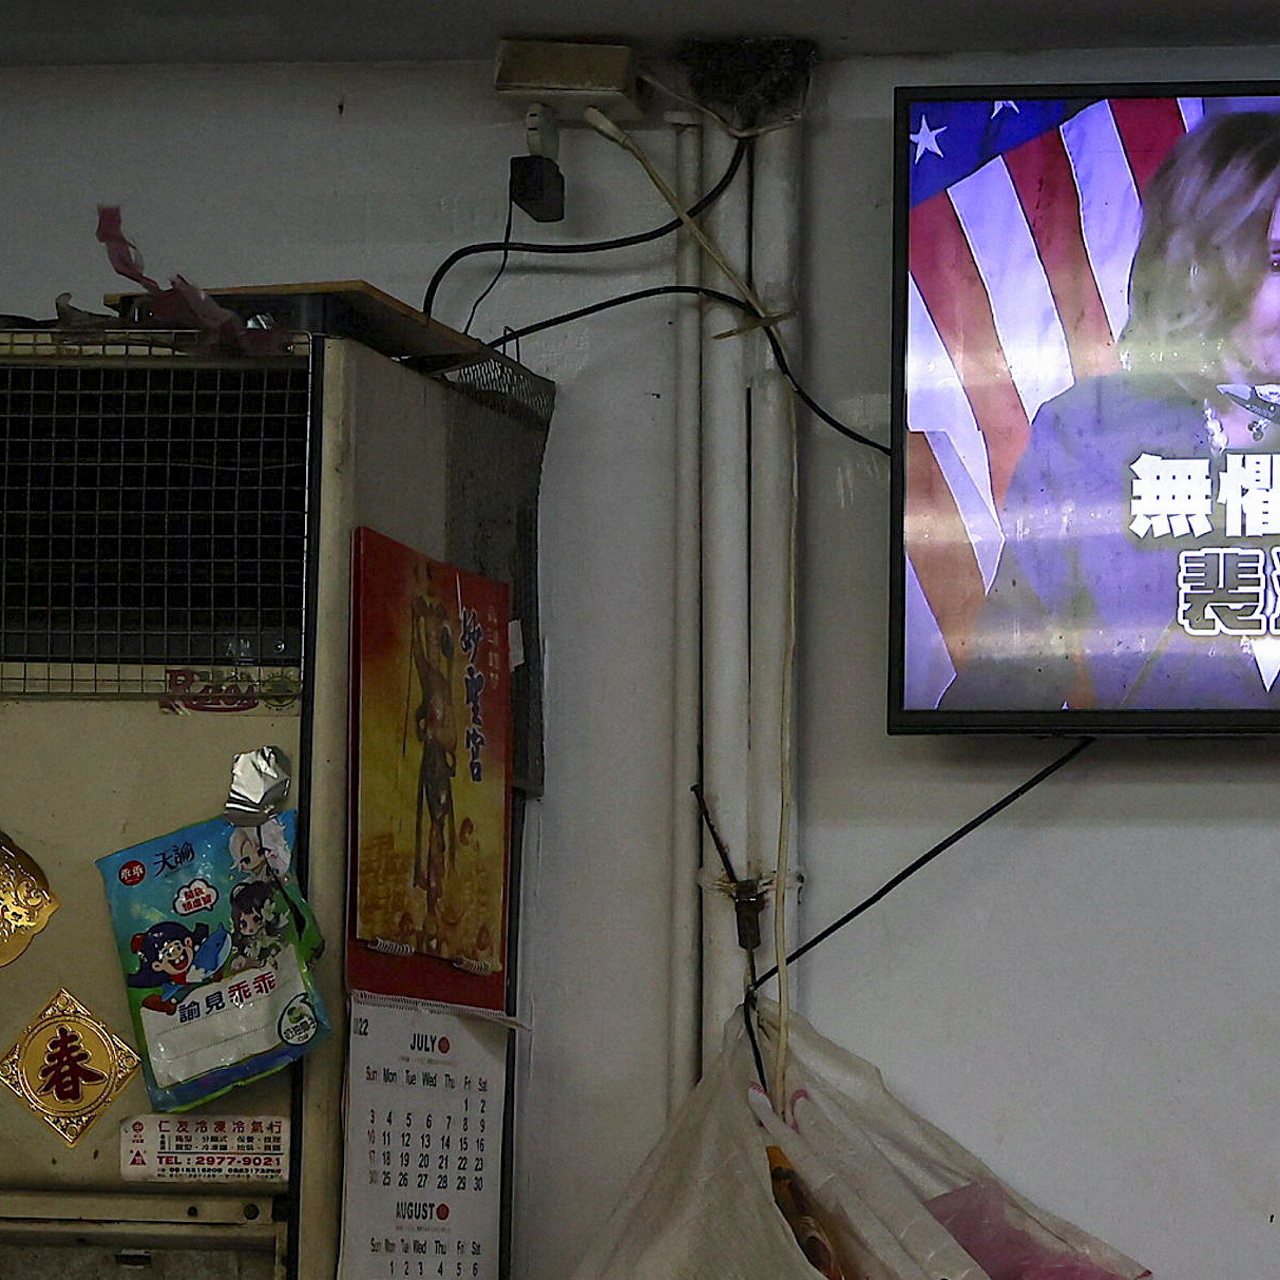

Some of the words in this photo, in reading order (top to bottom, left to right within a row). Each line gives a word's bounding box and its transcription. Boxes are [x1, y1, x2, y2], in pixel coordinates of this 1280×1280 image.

[178, 971, 277, 1023] 諭見乖乖
[410, 1033, 436, 1052] JULY
[36, 1024, 109, 1103] 春
[383, 1067, 397, 1083] Mon
[405, 1070, 416, 1085] Tue
[422, 1072, 437, 1087] Wed
[465, 1098, 468, 1111] 1
[481, 1099, 486, 1113] 2
[370, 1109, 375, 1124] 3
[387, 1111, 392, 1126] 4
[406, 1113, 412, 1127] 5
[427, 1114, 432, 1128] 6
[447, 1116, 451, 1129] 7
[463, 1117, 468, 1131] 8
[480, 1118, 485, 1133] 9
[383, 1131, 390, 1146] 11
[401, 1132, 411, 1147] 12
[421, 1134, 430, 1148] 13
[441, 1135, 450, 1149] 14
[460, 1136, 468, 1151] 15
[476, 1138, 484, 1152] 16
[195, 1156, 281, 1166] 2977-9021
[383, 1151, 391, 1166] 18
[400, 1152, 409, 1167] 19
[419, 1153, 429, 1168] 20
[439, 1155, 448, 1169] 21
[458, 1156, 467, 1170] 22
[475, 1157, 483, 1171] 23
[399, 1172, 408, 1187] 26
[417, 1173, 428, 1188] 27
[437, 1175, 448, 1189] 28
[456, 1176, 466, 1190] 29
[474, 1177, 483, 1191] 30
[396, 1201, 435, 1220] AUGUST
[435, 1240, 447, 1255] Thu
[390, 1260, 394, 1275] 1
[404, 1261, 409, 1275] 2
[418, 1261, 423, 1275] 3
[437, 1262, 443, 1276] 4
[456, 1262, 461, 1276] 5
[473, 1262, 478, 1276] 6
